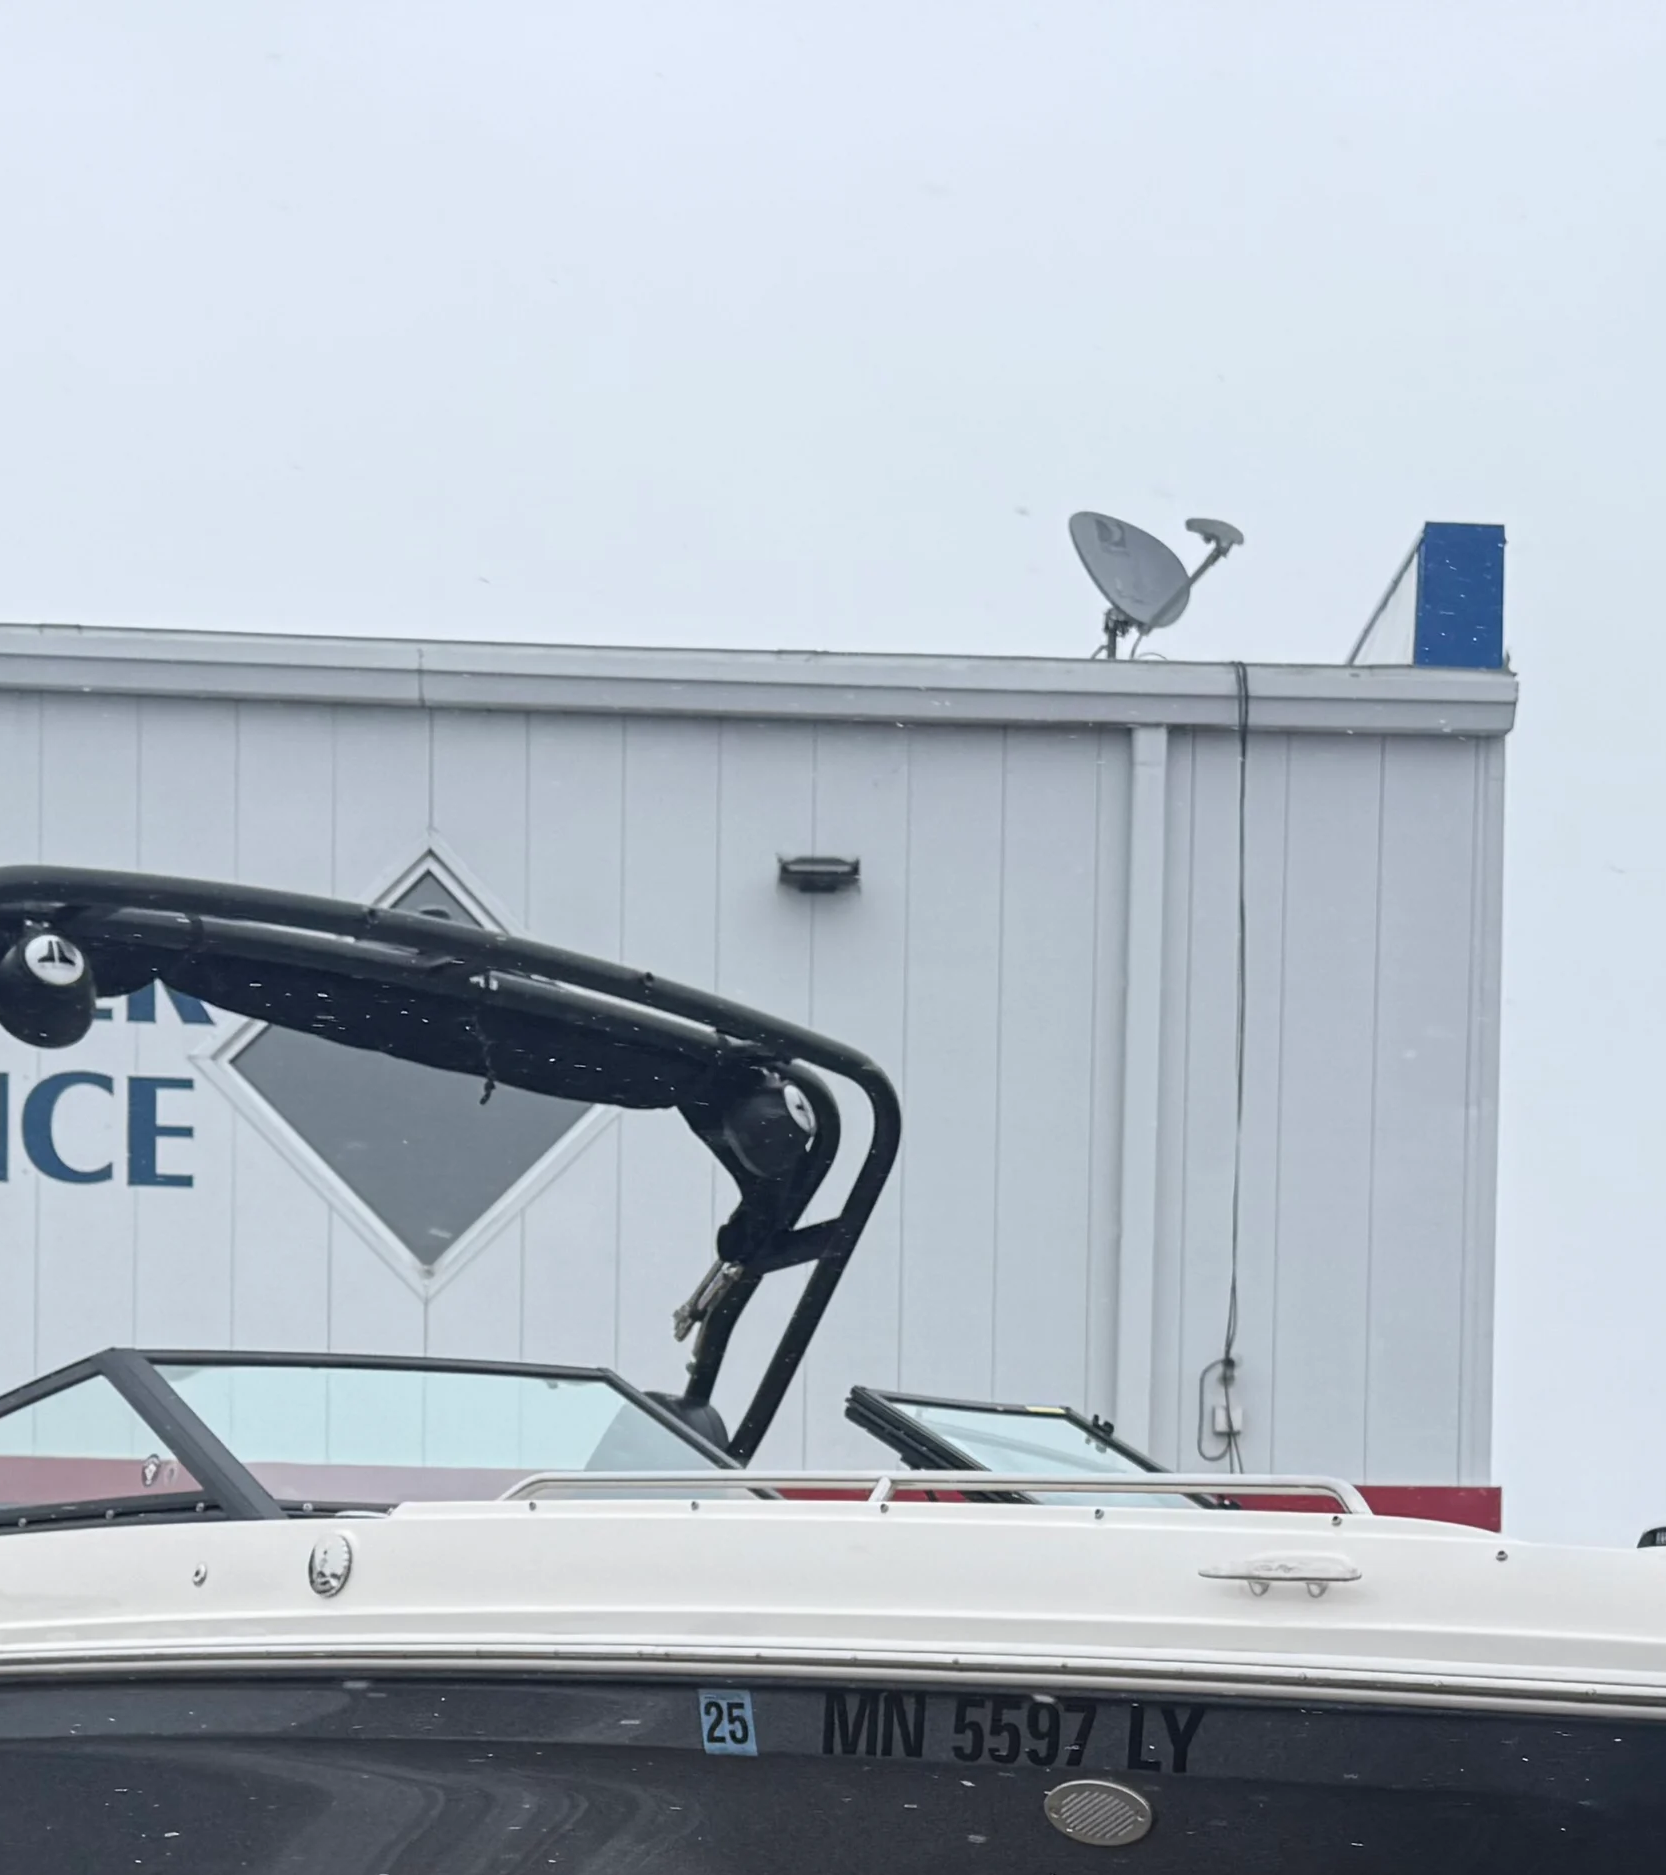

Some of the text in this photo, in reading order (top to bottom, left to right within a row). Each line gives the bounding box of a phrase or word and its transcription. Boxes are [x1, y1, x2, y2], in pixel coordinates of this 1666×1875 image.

[704, 1701, 749, 1745] 25
[823, 1690, 1206, 1774] MN 5597 LY
